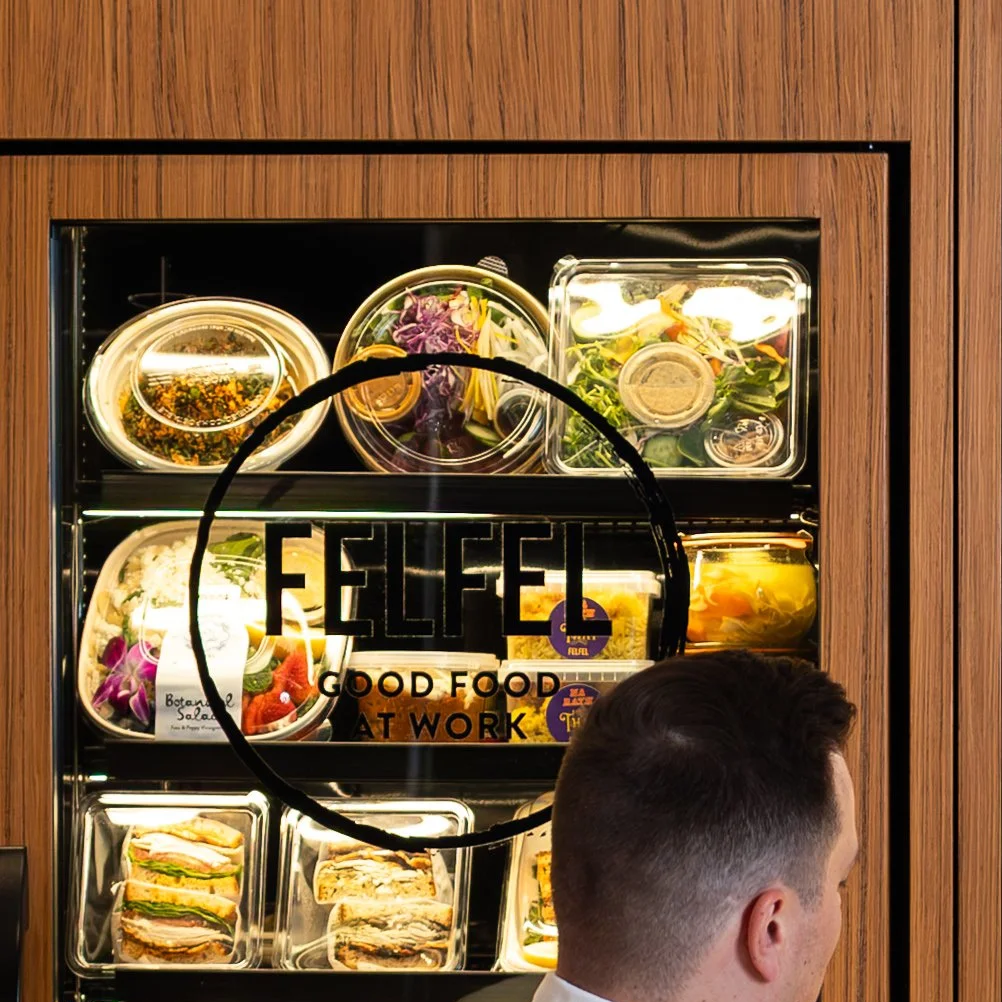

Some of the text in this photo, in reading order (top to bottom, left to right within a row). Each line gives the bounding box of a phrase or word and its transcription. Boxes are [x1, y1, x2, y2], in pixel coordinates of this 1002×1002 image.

[265, 522, 613, 636] FELFEL
[318, 671, 561, 698] GOOD FOOD
[177, 707, 217, 721] Sala
[357, 712, 528, 739] AT WORK
